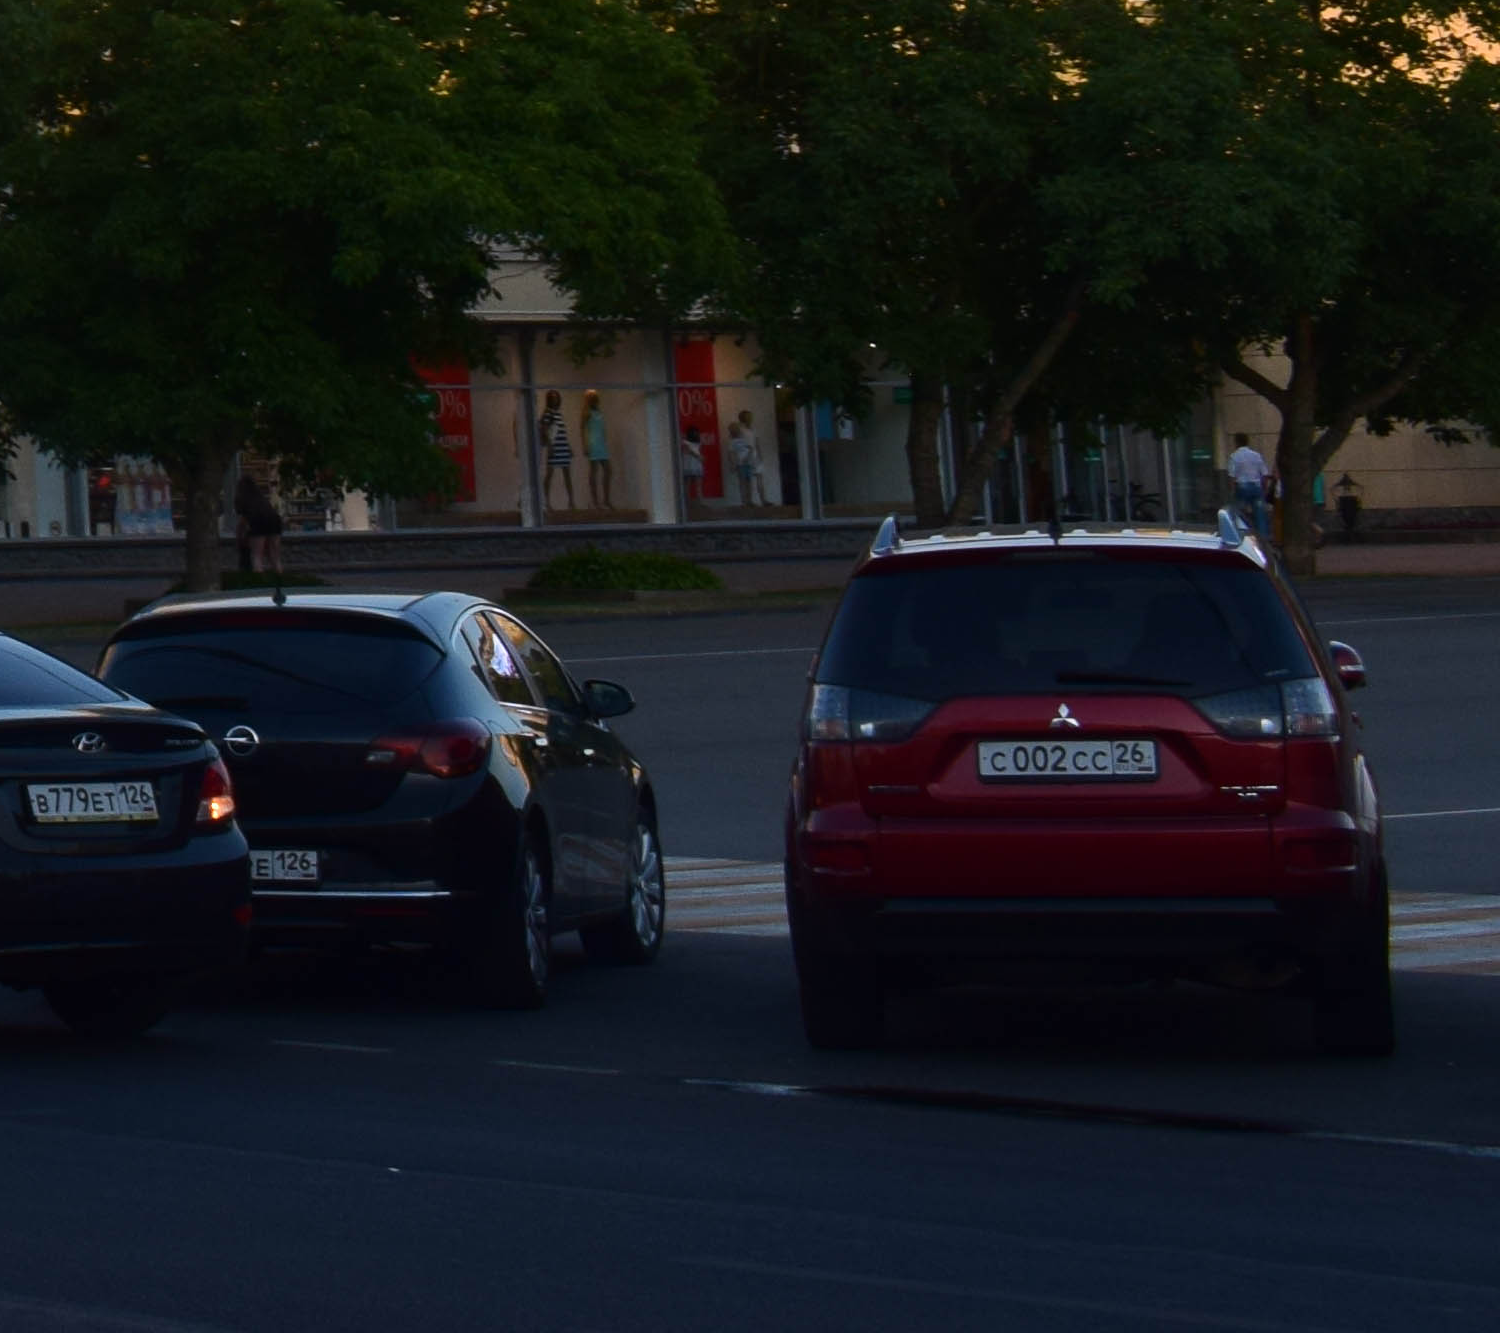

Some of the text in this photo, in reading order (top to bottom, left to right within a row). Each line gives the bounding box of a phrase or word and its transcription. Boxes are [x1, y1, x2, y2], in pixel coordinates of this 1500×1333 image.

[990, 742, 1145, 773] С002СС 26
[35, 784, 151, 814] В779ЕТ 126
[275, 851, 311, 872] 126
